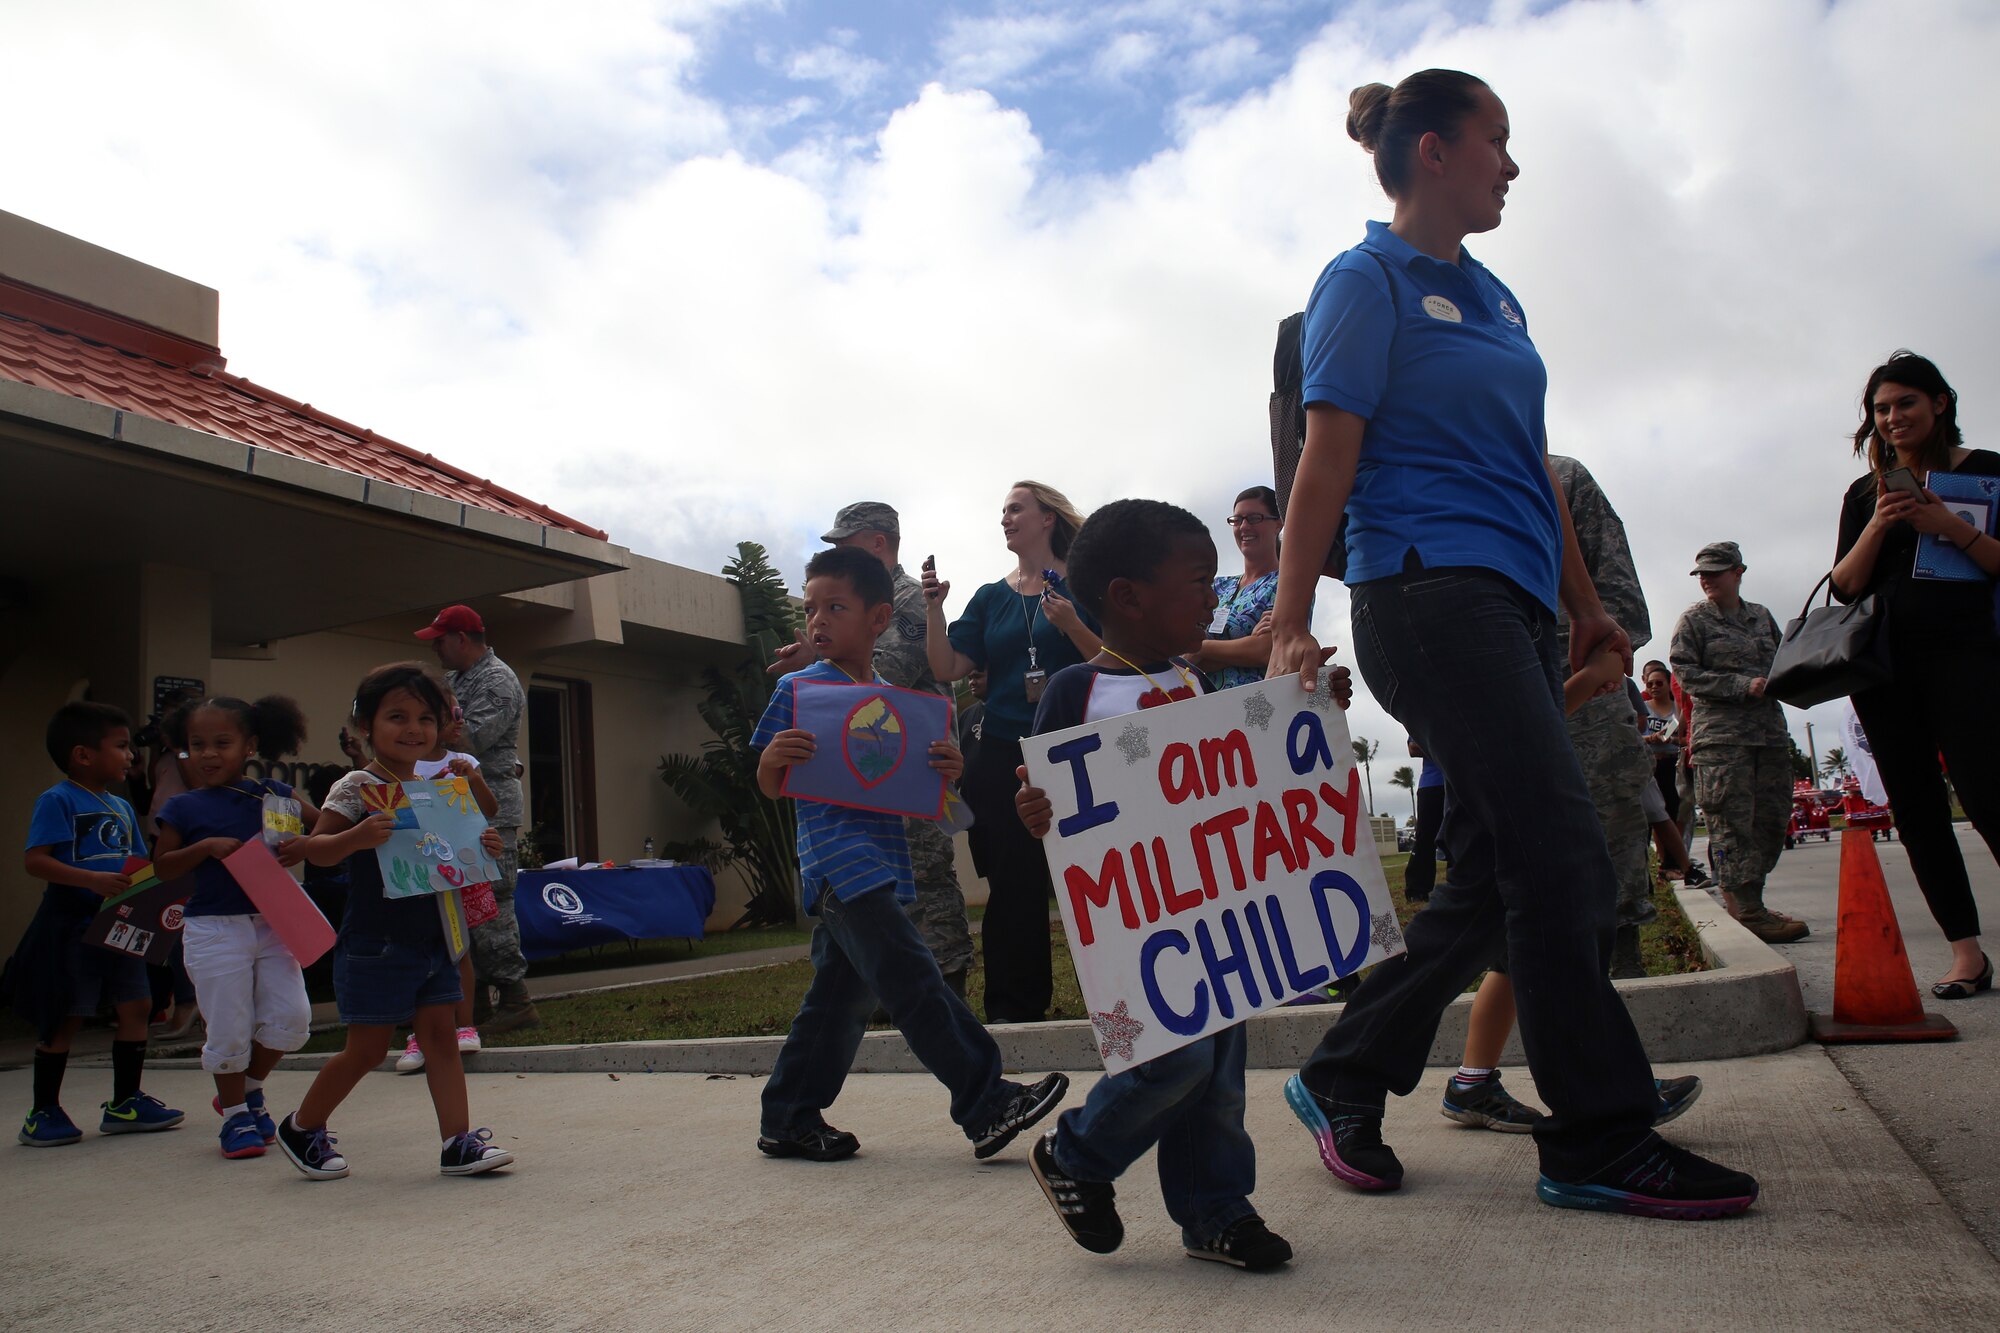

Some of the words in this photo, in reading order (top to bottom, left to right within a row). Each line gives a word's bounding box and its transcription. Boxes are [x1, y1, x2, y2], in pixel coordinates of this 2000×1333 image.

[1047, 733, 1120, 838] I
[1158, 728, 1258, 805] am
[1286, 710, 1334, 775] a
[1063, 767, 1360, 947] MILITARY
[1139, 869, 1371, 1036] CHILD
